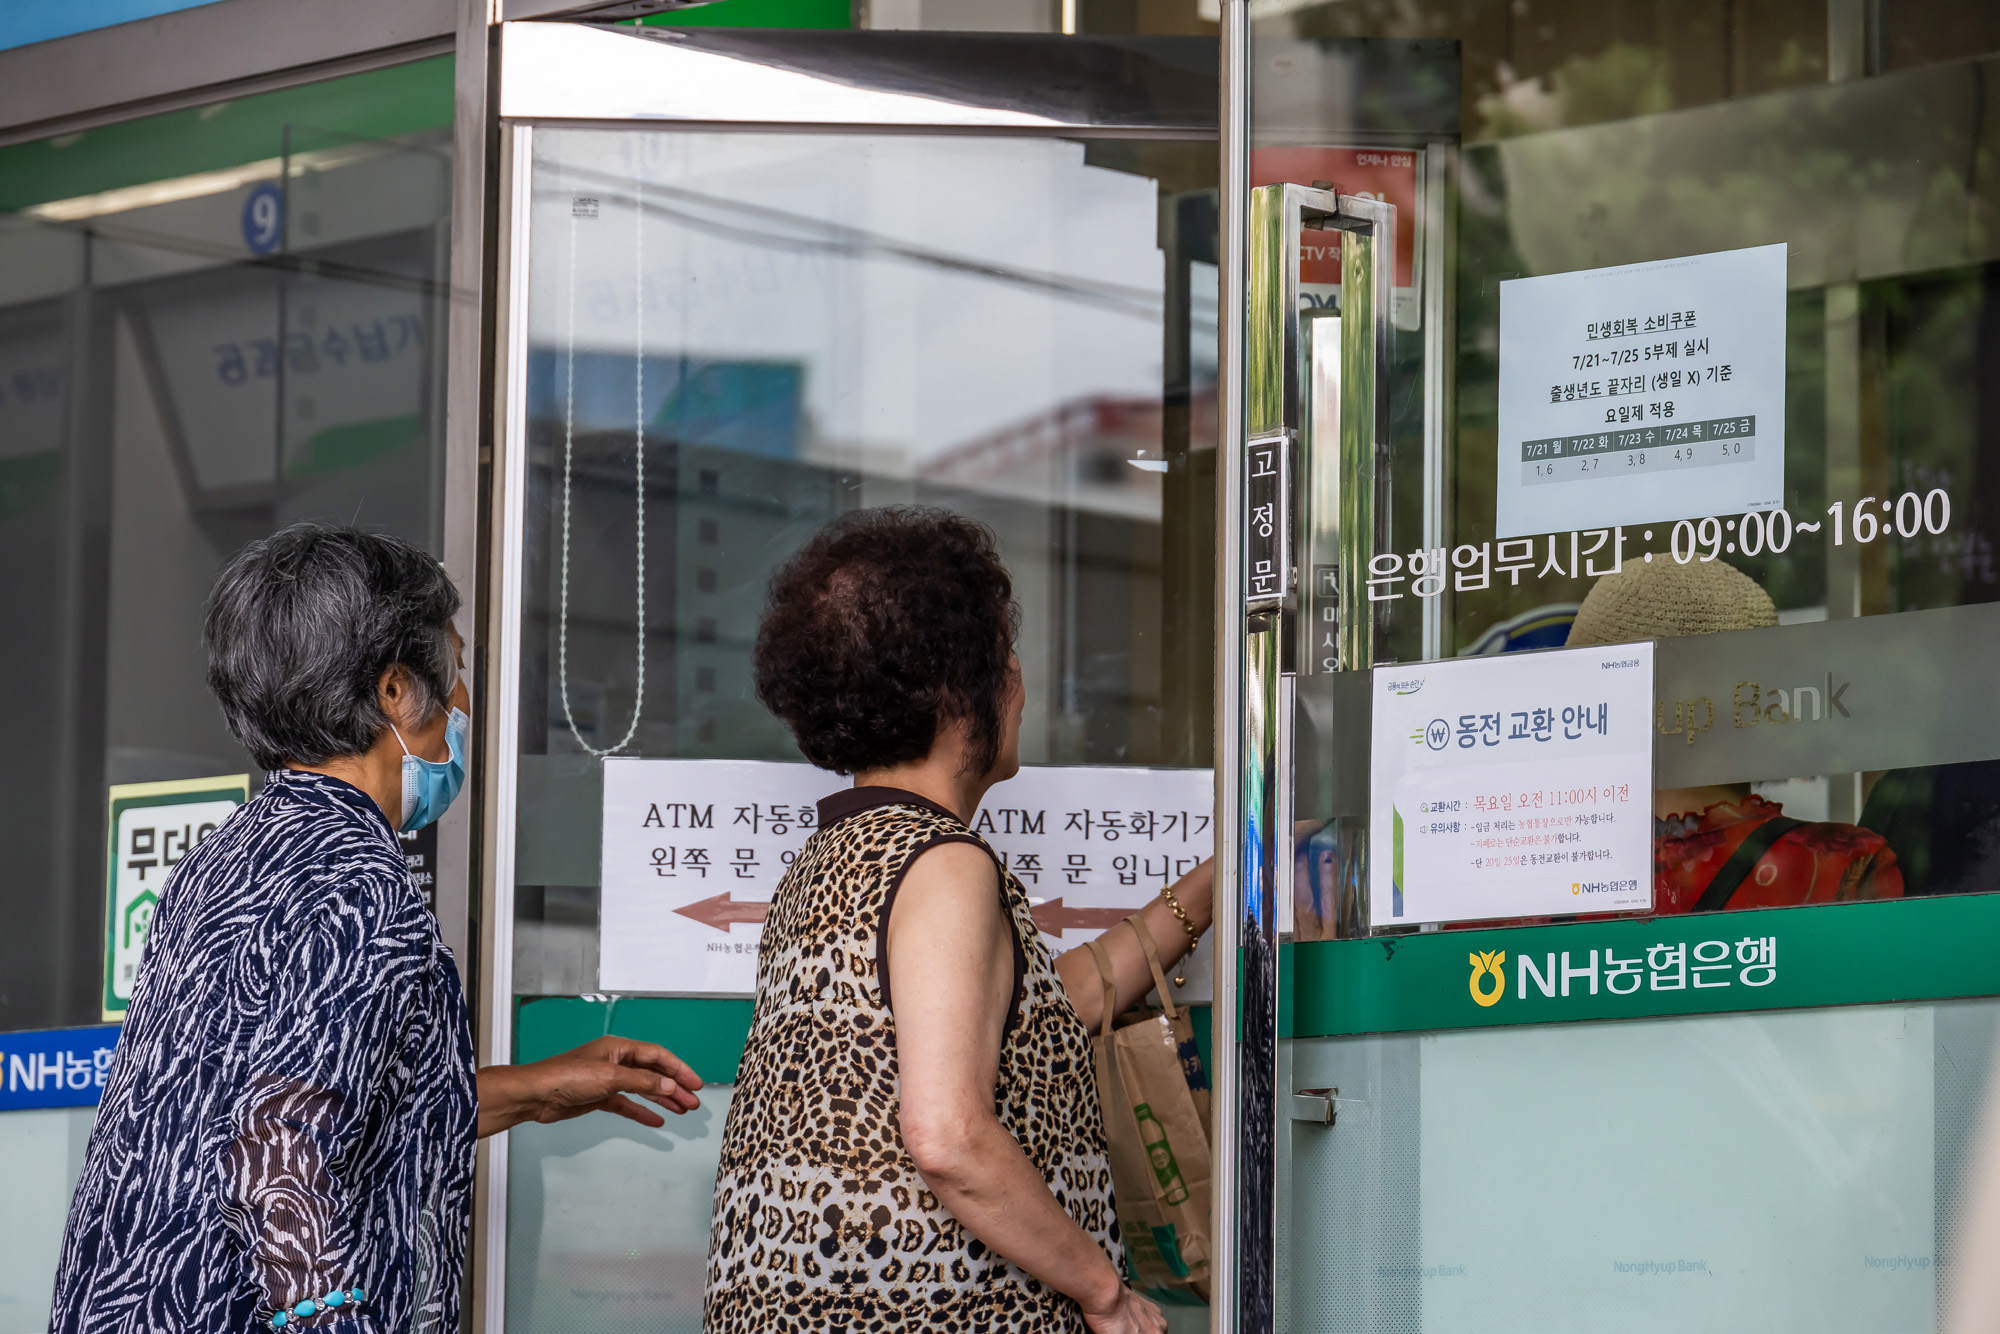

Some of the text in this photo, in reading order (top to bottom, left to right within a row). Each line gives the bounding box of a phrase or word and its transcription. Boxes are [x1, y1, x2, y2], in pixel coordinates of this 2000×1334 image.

[1356, 154, 1412, 167] 언제나 안심
[252, 193, 277, 245] 9
[1586, 310, 1696, 340] 민생회복 소비쿠폰
[1573, 338, 1709, 370] 7/21~7/25 5부제 실시
[1550, 365, 1732, 403] 출생년도 끝자리 (생일 X) 기준
[1605, 401, 1675, 424] 요일제 적용
[1527, 419, 1750, 457] 7/21 월 7/22 화 7/23 수 7/24 목 7/25 금
[1547, 464, 1552, 474] 6
[1582, 460, 1589, 471] 2,
[1593, 459, 1599, 469] 7
[1628, 455, 1636, 466] 3,
[1640, 454, 1645, 465] 8
[1675, 450, 1682, 461] 4,
[1687, 448, 1692, 459] 9
[1722, 444, 1730, 456] 5,
[1734, 443, 1740, 454] 0
[1251, 450, 1277, 593] 고정문
[1365, 526, 1628, 602] 은행업무시간
[1670, 489, 1952, 564] 09:00~16:00
[1734, 671, 1851, 729] Bank
[1456, 712, 1501, 749] 동전
[1508, 708, 1555, 742] 교환
[1561, 703, 1608, 740] 안내
[1430, 800, 1461, 813] 교환시간
[1473, 793, 1512, 813] 목요일
[1517, 791, 1544, 808] 오전
[1550, 787, 1597, 806] 11:00시
[1603, 783, 1629, 803] 이전
[642, 803, 819, 835] ATM 자동화
[978, 809, 1046, 834] ATM
[1430, 821, 1461, 834] 유의사항
[1493, 819, 1515, 831] 처리는
[1518, 816, 1572, 829] 농협통장으로만
[1575, 813, 1616, 825] 가능합니다.
[1506, 835, 1542, 848] 단순교환은
[1544, 833, 1582, 844] 불가합니다.
[649, 846, 712, 878] 왼쪽
[729, 848, 760, 878] 문
[1000, 851, 1043, 884] 쪽
[1062, 854, 1092, 884] 문
[1485, 857, 1501, 867] 20일
[1504, 855, 1528, 866] 25일은
[1530, 852, 1569, 865] 동전교환이
[1571, 849, 1613, 861] 불가합니다.
[1582, 879, 1637, 894] NH농협은행
[1518, 936, 1778, 1000] NH농협은행
[9, 1047, 116, 1094] NH농협
[1439, 1264, 1466, 1276] Bank
[1613, 1258, 1707, 1276] NongHyup Bank
[1864, 1255, 1930, 1270] NongHyup
